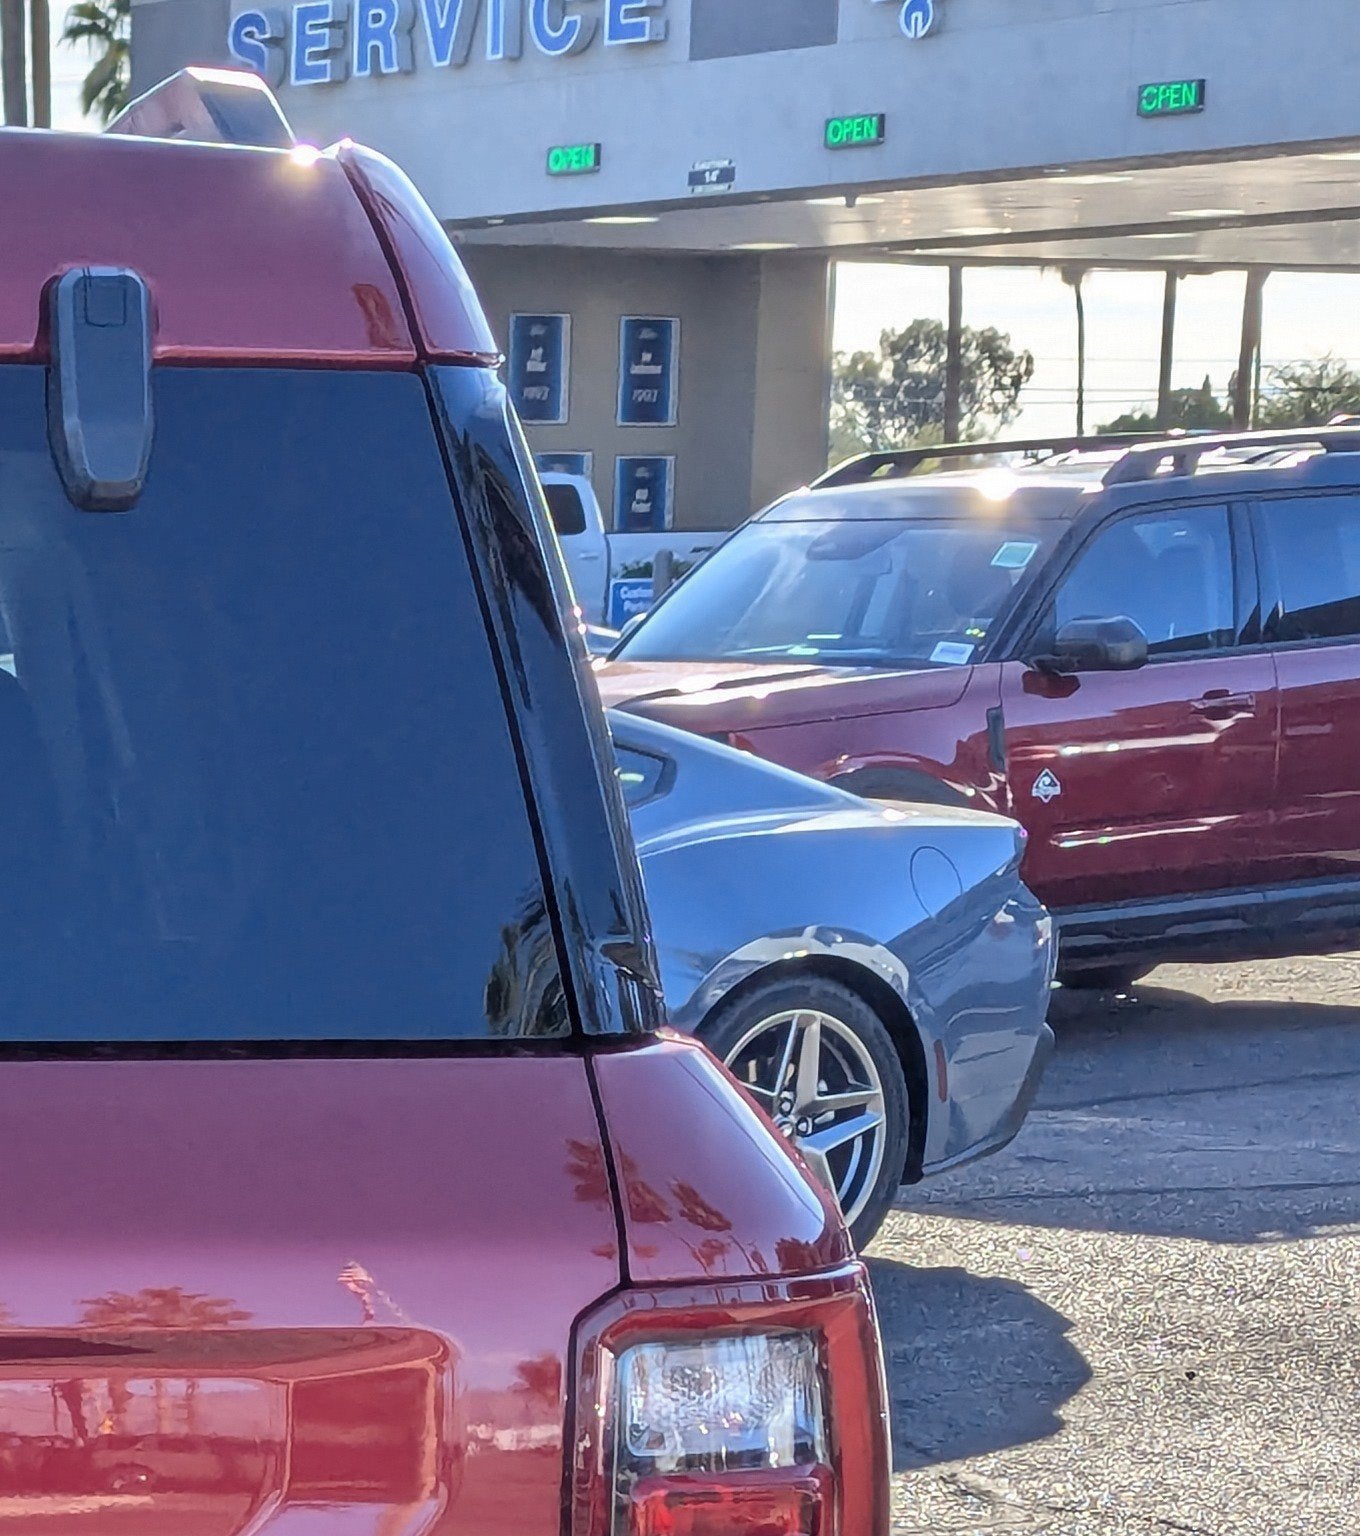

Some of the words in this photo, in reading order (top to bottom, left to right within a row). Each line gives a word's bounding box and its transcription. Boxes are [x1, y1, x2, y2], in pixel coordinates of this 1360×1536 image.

[227, 0, 652, 86] SERVICE
[1140, 82, 1197, 112] OPEN
[830, 117, 877, 143] OPEN
[548, 144, 594, 171] OPEN
